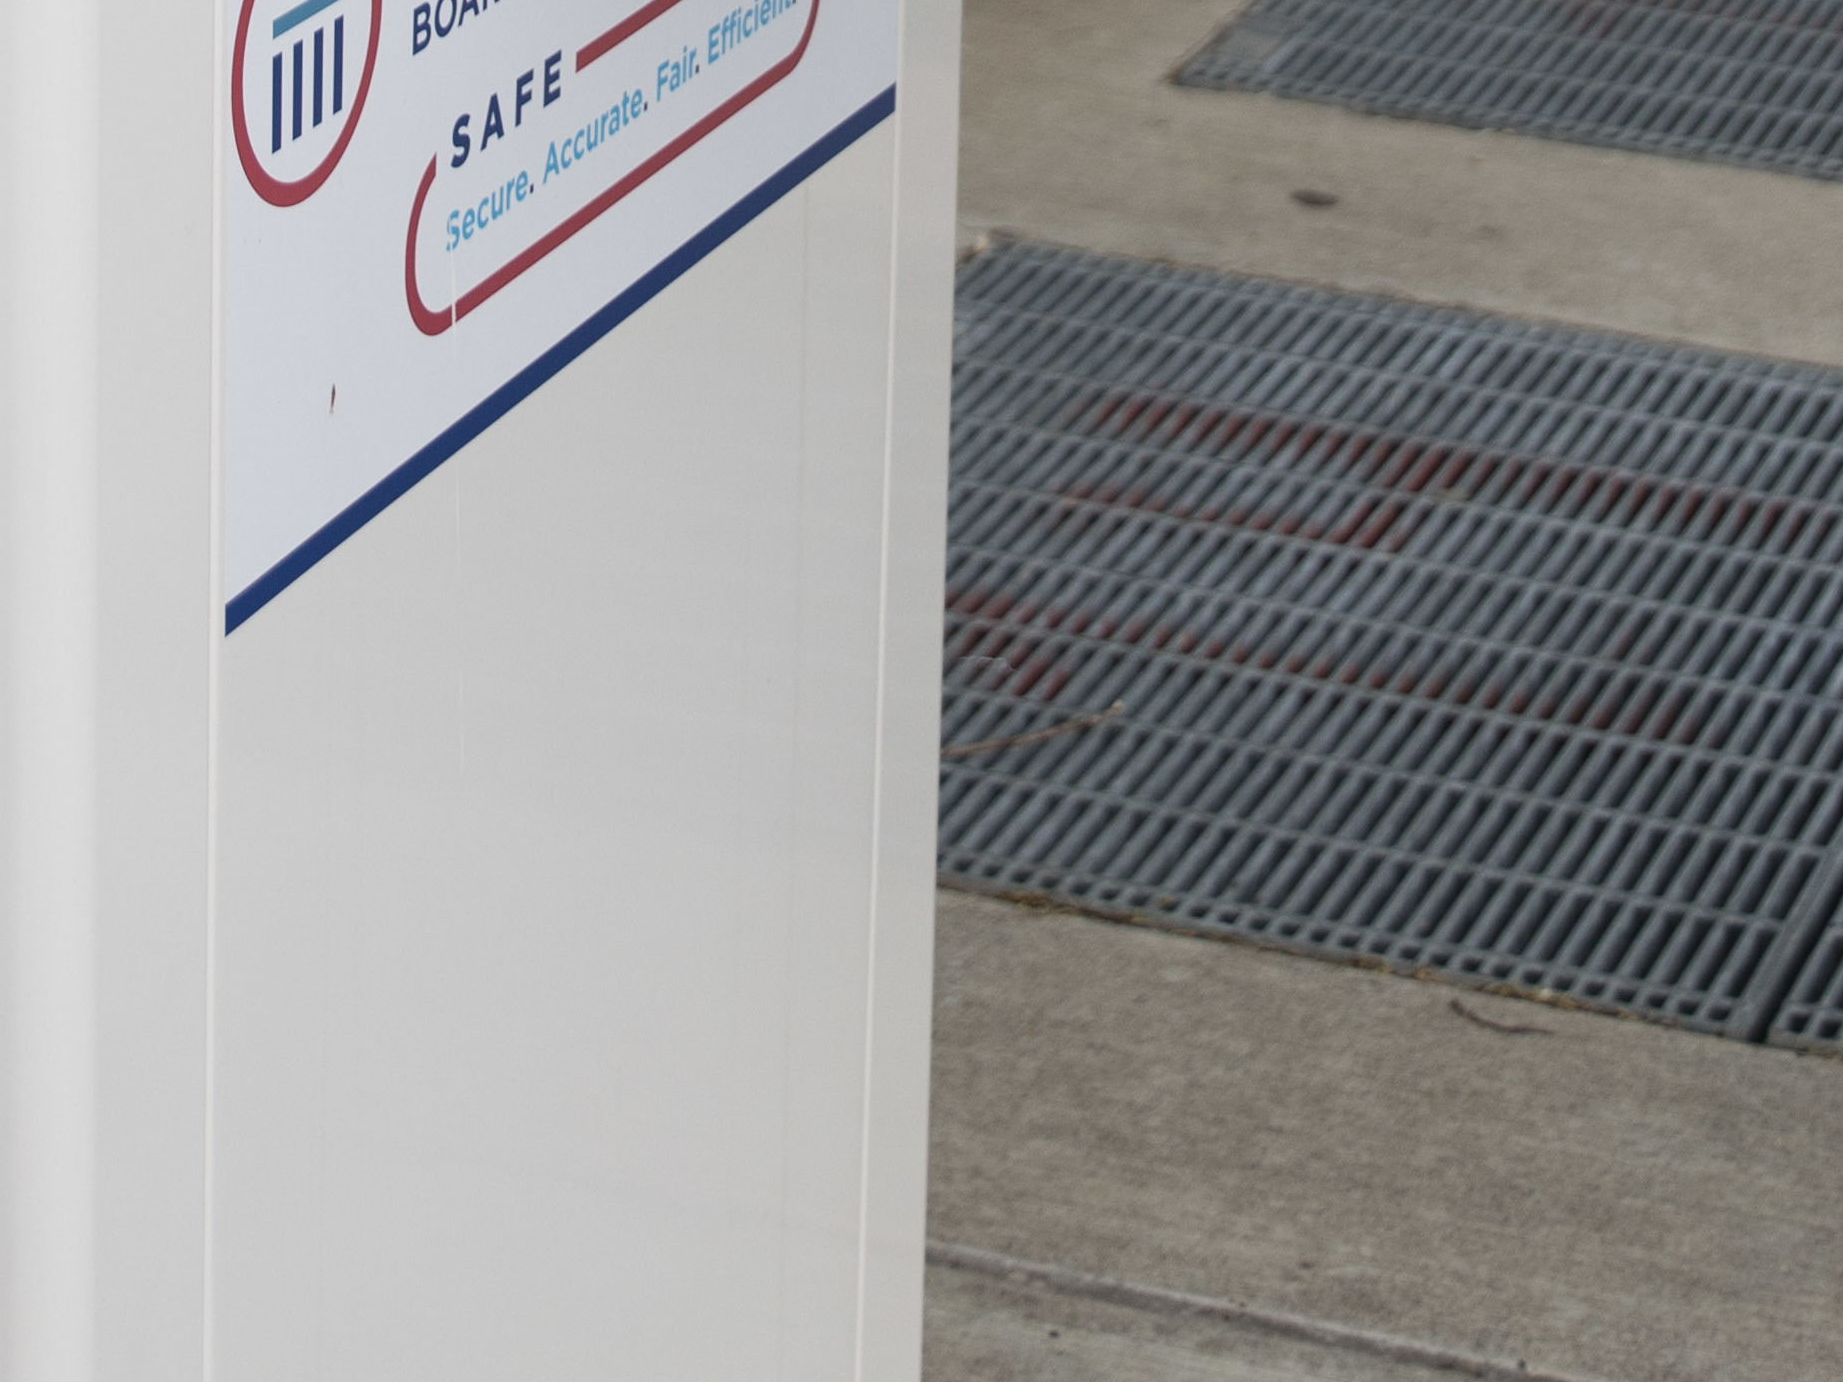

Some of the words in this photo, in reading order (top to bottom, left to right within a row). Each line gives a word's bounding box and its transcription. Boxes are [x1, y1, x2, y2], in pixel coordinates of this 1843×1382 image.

[446, 170, 534, 250] Secure.
[542, 88, 648, 185] Accurate.
[655, 49, 701, 103] Fair.
[449, 49, 563, 170] SAFE
